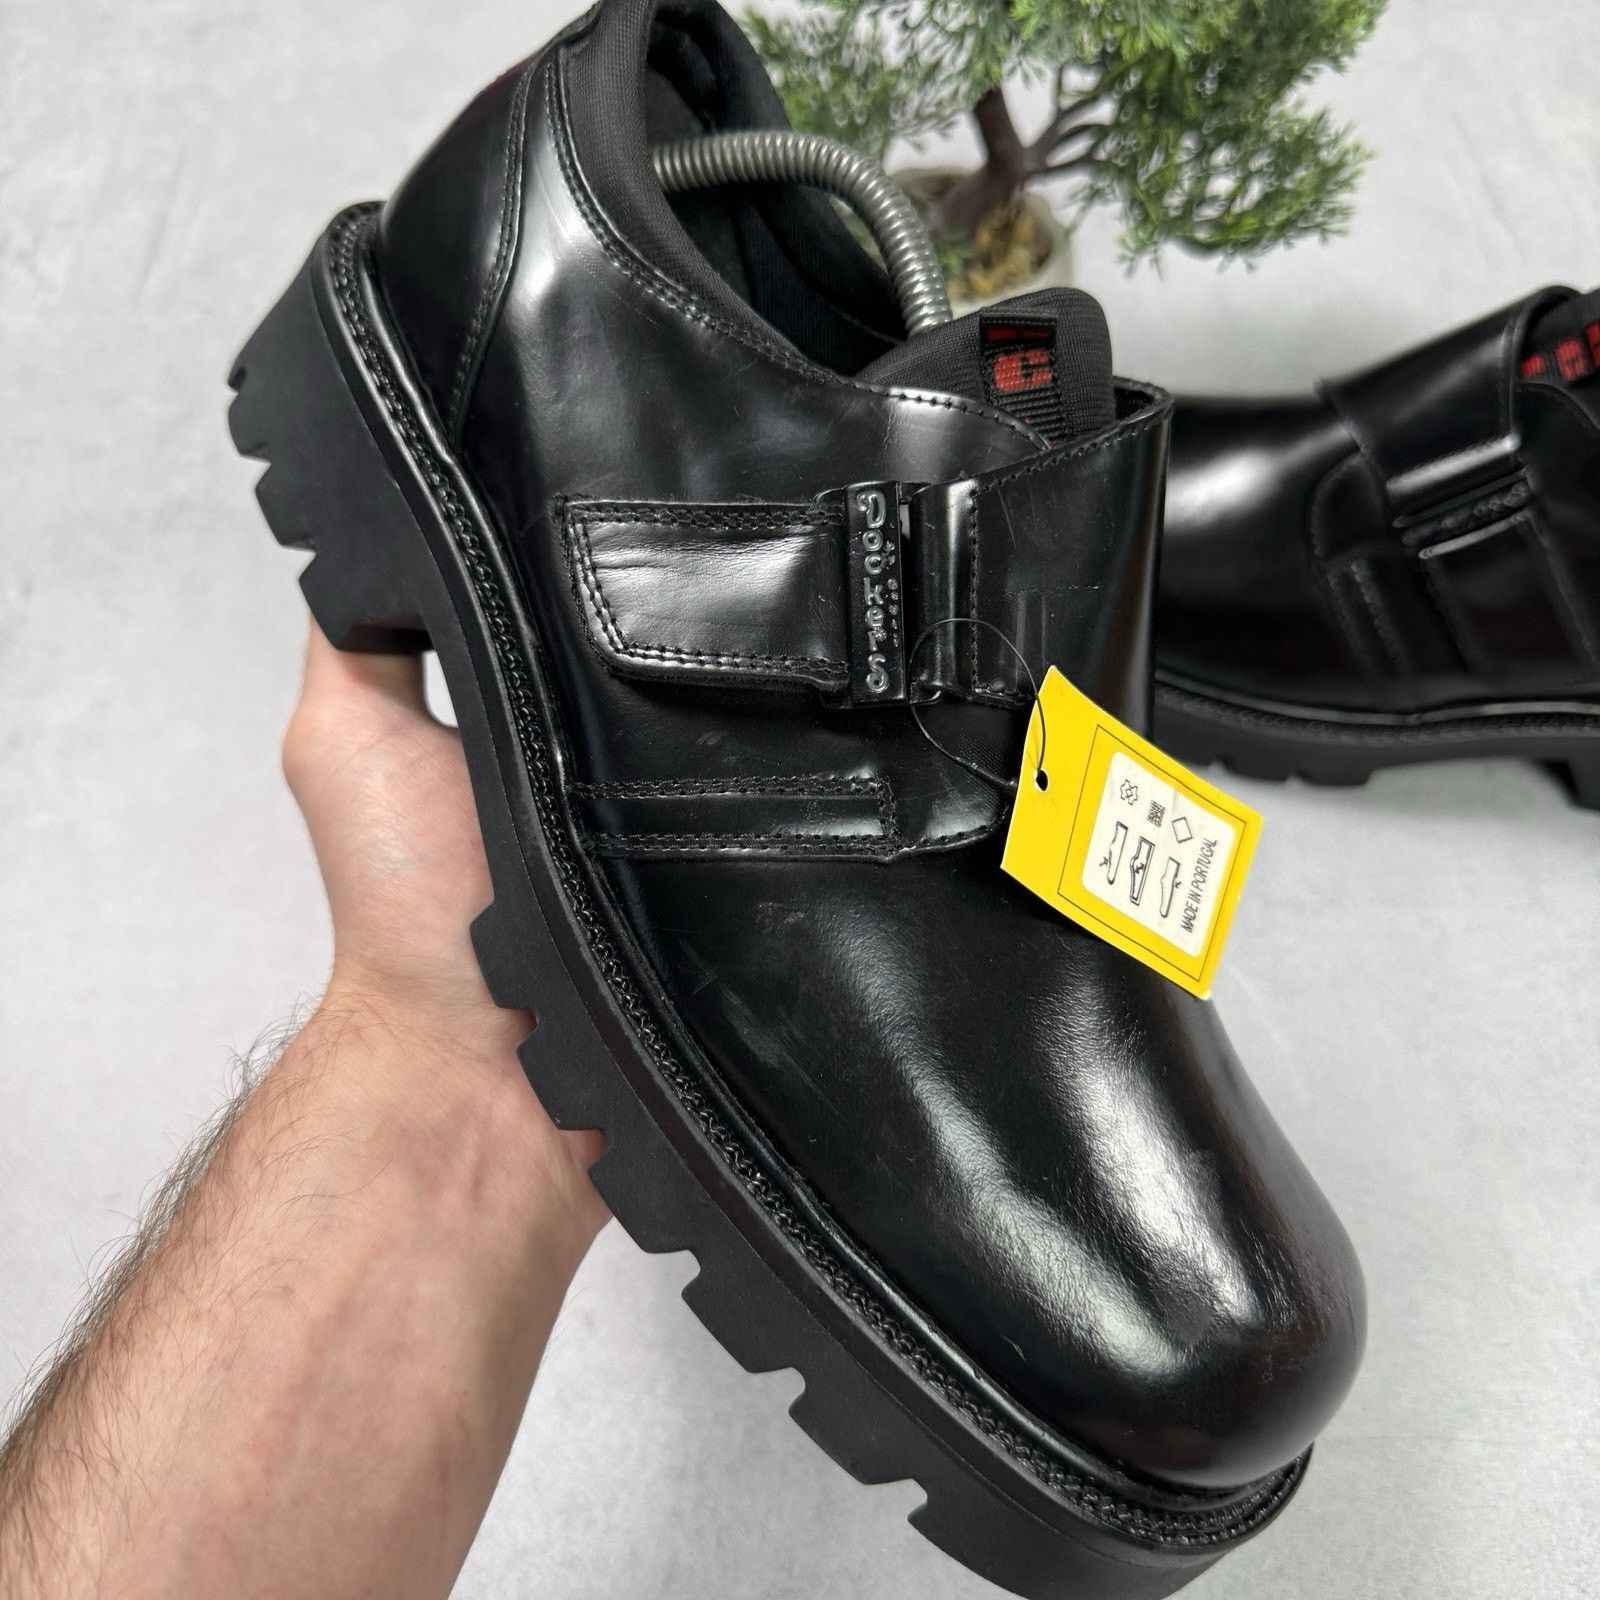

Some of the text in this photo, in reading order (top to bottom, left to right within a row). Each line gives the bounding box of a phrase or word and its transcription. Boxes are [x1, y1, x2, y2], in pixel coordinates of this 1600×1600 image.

[1180, 838, 1217, 933] MADE IN PORTUGAL
